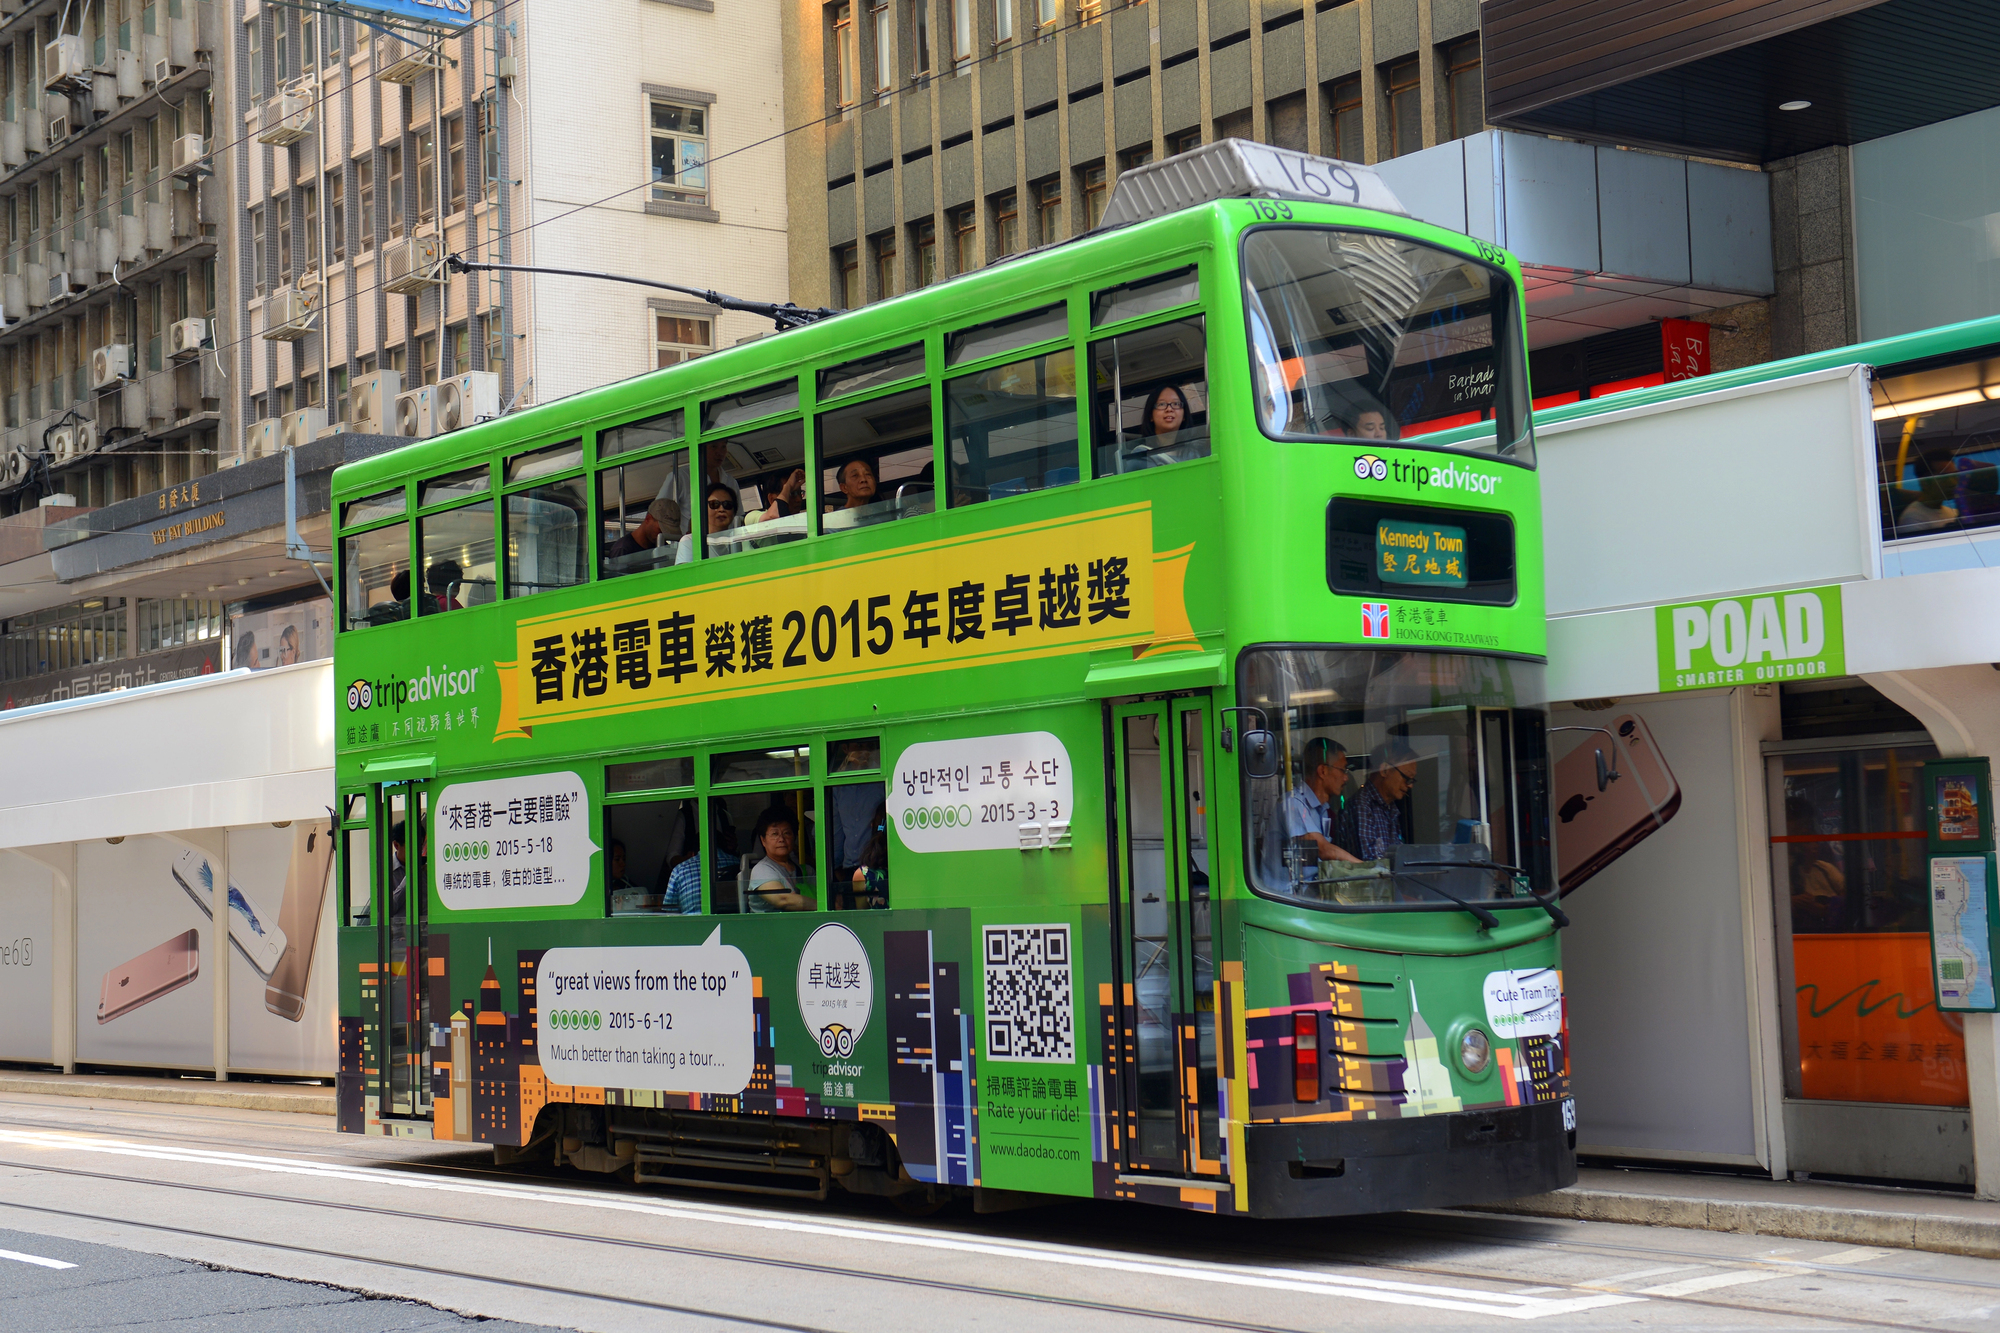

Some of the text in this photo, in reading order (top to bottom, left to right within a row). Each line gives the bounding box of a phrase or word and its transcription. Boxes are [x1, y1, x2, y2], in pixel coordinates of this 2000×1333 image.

[1274, 151, 1359, 203] 169
[1246, 201, 1293, 220] 169
[1471, 239, 1505, 265] 169
[159, 482, 200, 510] 日發大廈
[152, 511, 225, 545] YAT FAT BUILDING
[1379, 527, 1429, 553] Kennedy
[1433, 532, 1463, 552] Town
[1383, 552, 1462, 578] 堅尼地城
[1395, 606, 1448, 626] 香港電車
[531, 556, 1130, 705] 香港電車榮獲2015年度卓越獎
[1396, 628, 1499, 647] HONG KONG TRAMWAYS
[1672, 592, 1825, 670] POAD
[159, 666, 199, 682] CENTRAL DISTRICT
[1676, 661, 1826, 687] SMARTER OUTDOOR
[903, 758, 1059, 796] 낭만적인 교통 수단
[593, 970, 630, 991] views
[635, 970, 668, 990] from
[673, 970, 697, 991] the
[808, 962, 860, 989] 卓越獎
[821, 999, 848, 1009] 2015年度
[1520, 987, 1543, 1000] Tram
[551, 1045, 579, 1061] Much
[581, 1046, 611, 1063] better
[615, 1046, 639, 1063] than
[642, 1047, 676, 1069] taking
[679, 1053, 686, 1065] a
[812, 1061, 863, 1079] tripadvisor
[986, 1075, 1078, 1100] 掃碼評論電車
[987, 1101, 1080, 1124] Rate your ride!
[1562, 1098, 1576, 1131] 169
[990, 1143, 1080, 1161] www.daodao.com
